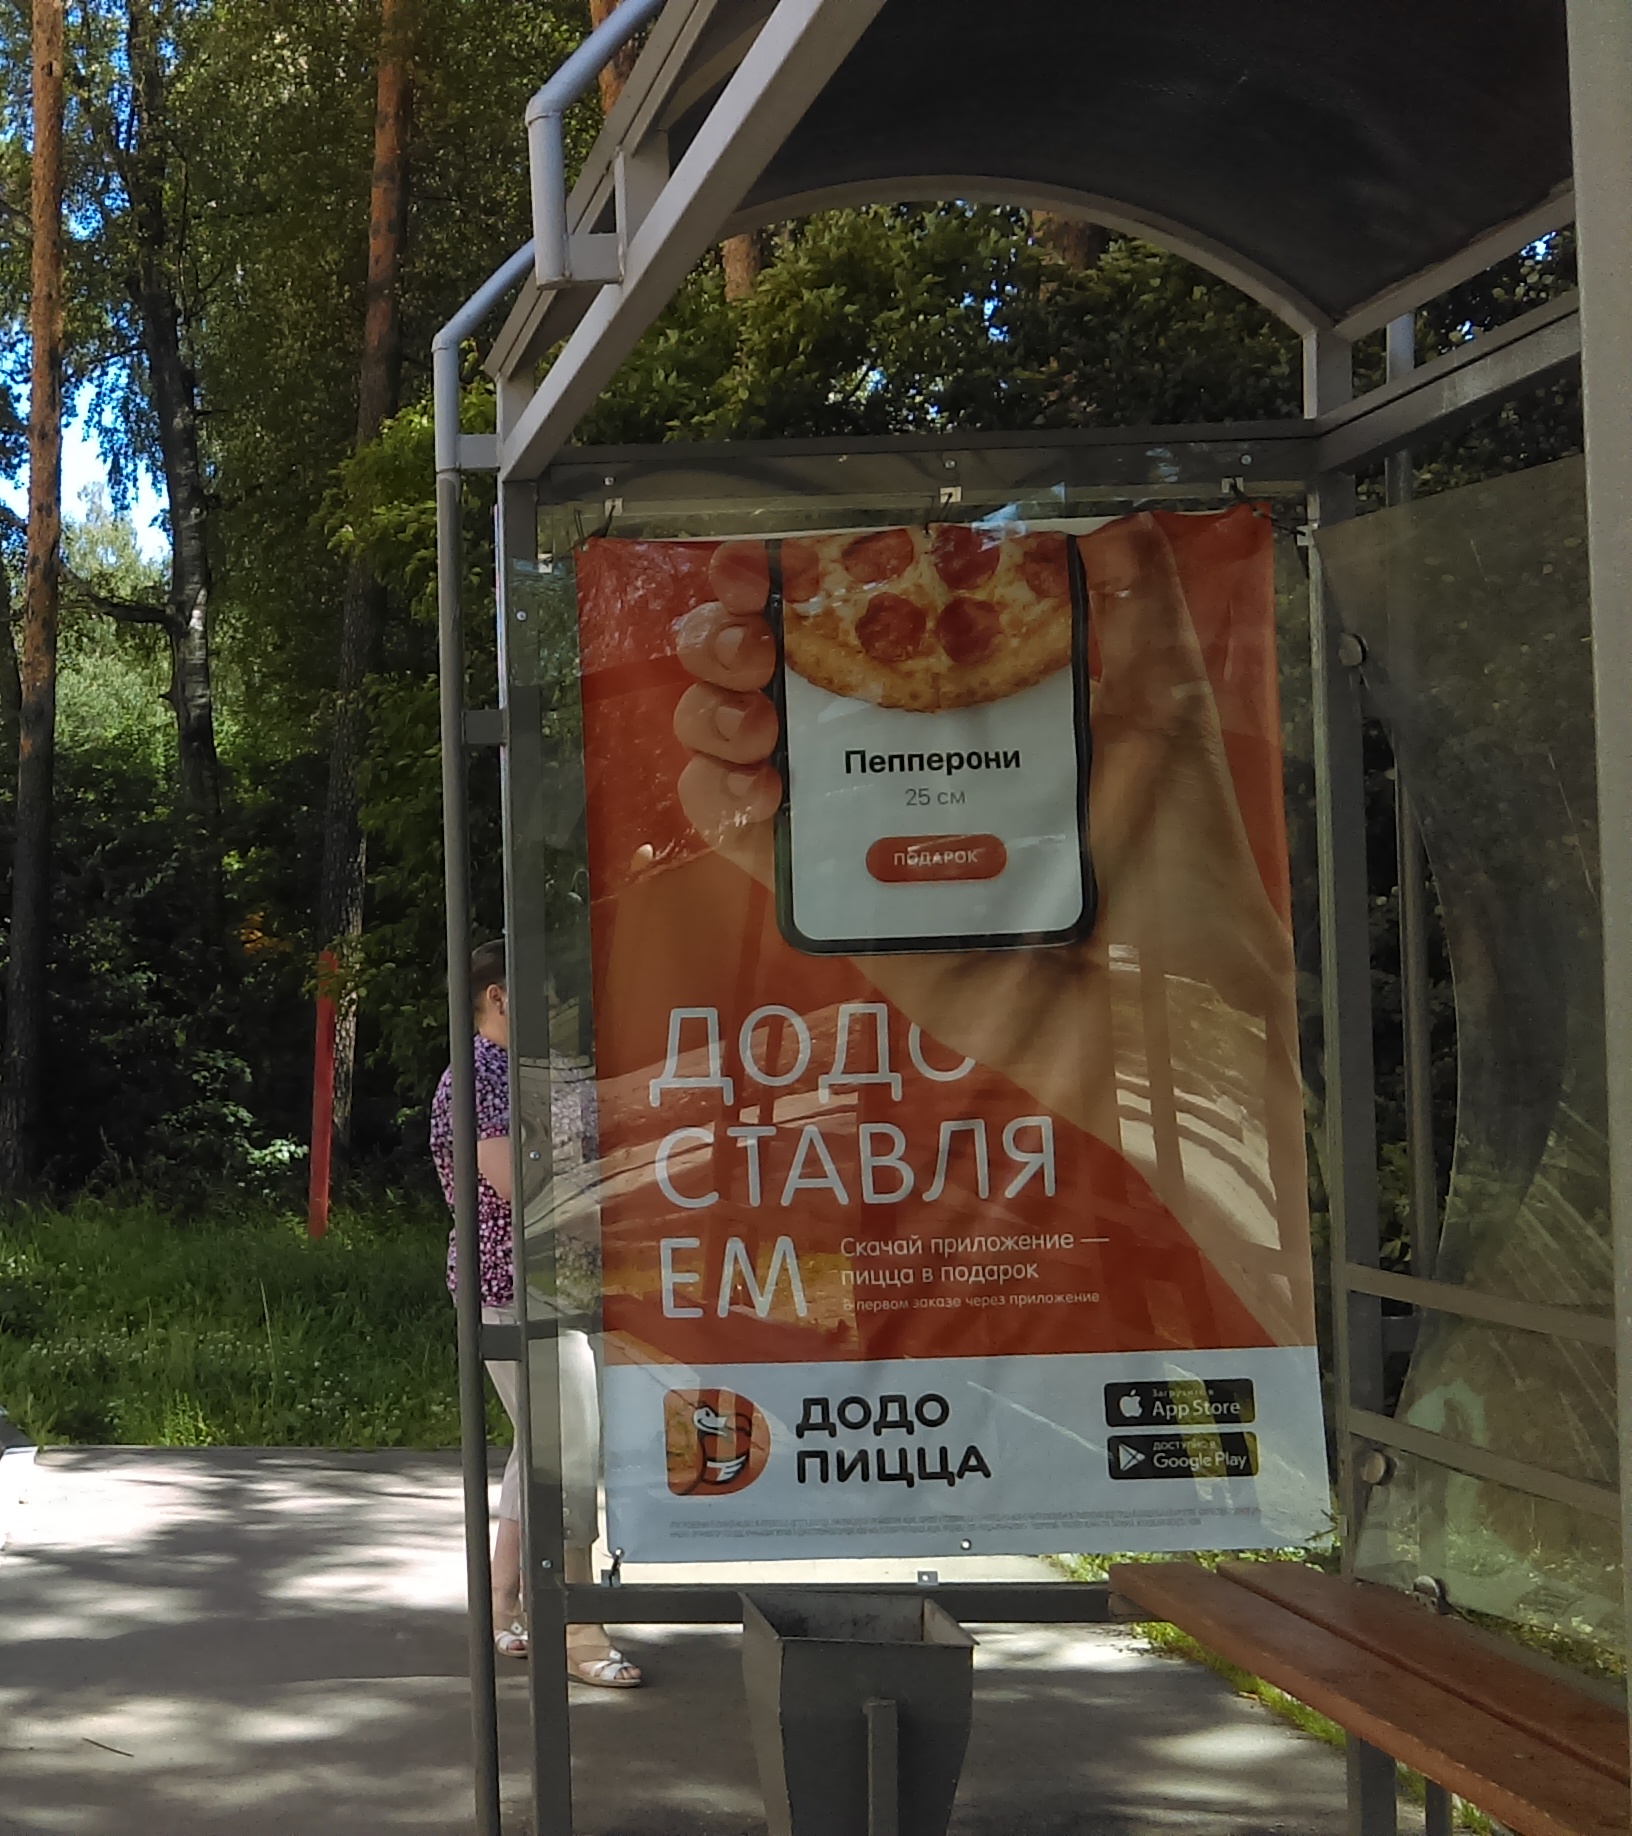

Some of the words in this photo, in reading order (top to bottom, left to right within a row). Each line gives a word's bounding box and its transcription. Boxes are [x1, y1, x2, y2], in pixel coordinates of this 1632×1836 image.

[844, 749, 1021, 776] Пепперони
[905, 788, 931, 806] 25
[937, 791, 966, 805] см
[894, 850, 978, 866] ПОДАРОК
[654, 1116, 1057, 1209] СТАВЛЯ
[840, 1235, 923, 1257] Скачай
[930, 1232, 1074, 1258] приложение
[659, 1235, 809, 1318] ЕМ
[841, 1267, 914, 1288] пицца
[922, 1268, 934, 1283] в
[940, 1261, 1040, 1285] подарок
[856, 1299, 909, 1313] первом
[912, 1297, 962, 1309] заказе
[965, 1295, 1006, 1308] через
[1009, 1291, 1100, 1307] приложение
[795, 1393, 950, 1439] ДОДО
[1152, 1400, 1190, 1420] App
[1192, 1399, 1241, 1416] Store
[796, 1444, 992, 1489] ПИЦЦА
[1153, 1451, 1212, 1471] Google
[1214, 1450, 1247, 1469] Play
